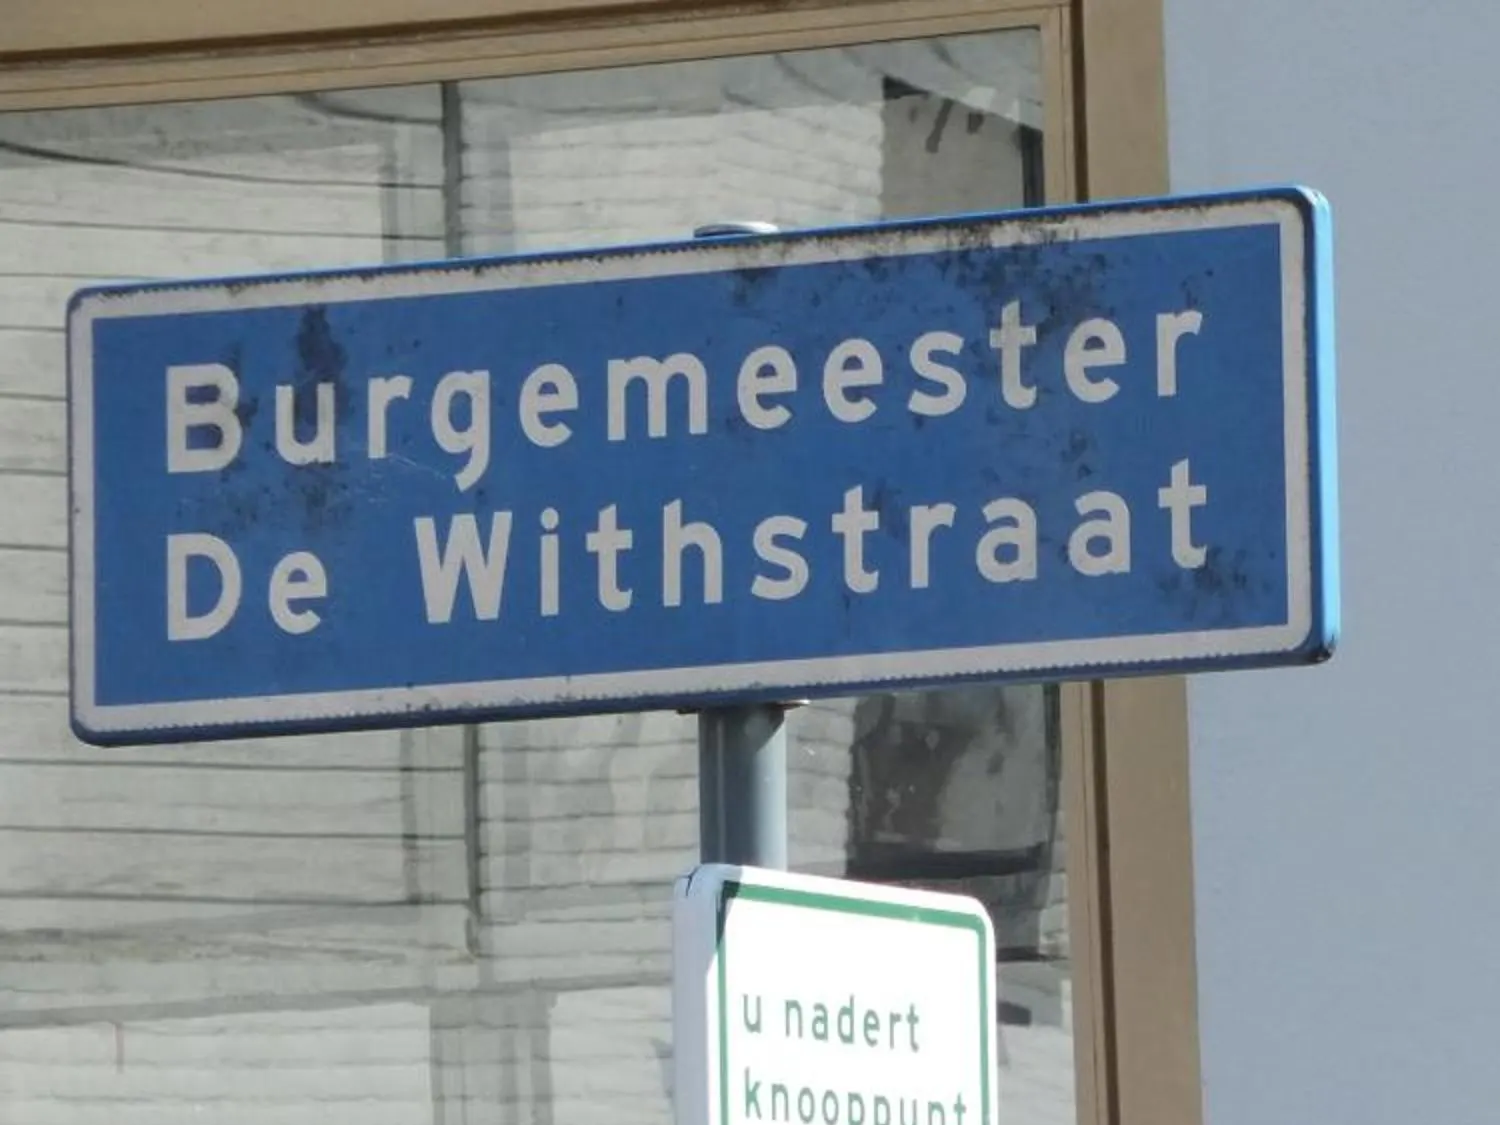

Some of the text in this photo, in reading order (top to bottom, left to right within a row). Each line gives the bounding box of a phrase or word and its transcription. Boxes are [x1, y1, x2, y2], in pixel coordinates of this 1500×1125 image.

[166, 301, 1203, 491] Burgemeester
[166, 459, 1208, 641] De Withstraat
[742, 993, 919, 1053] u nadert
